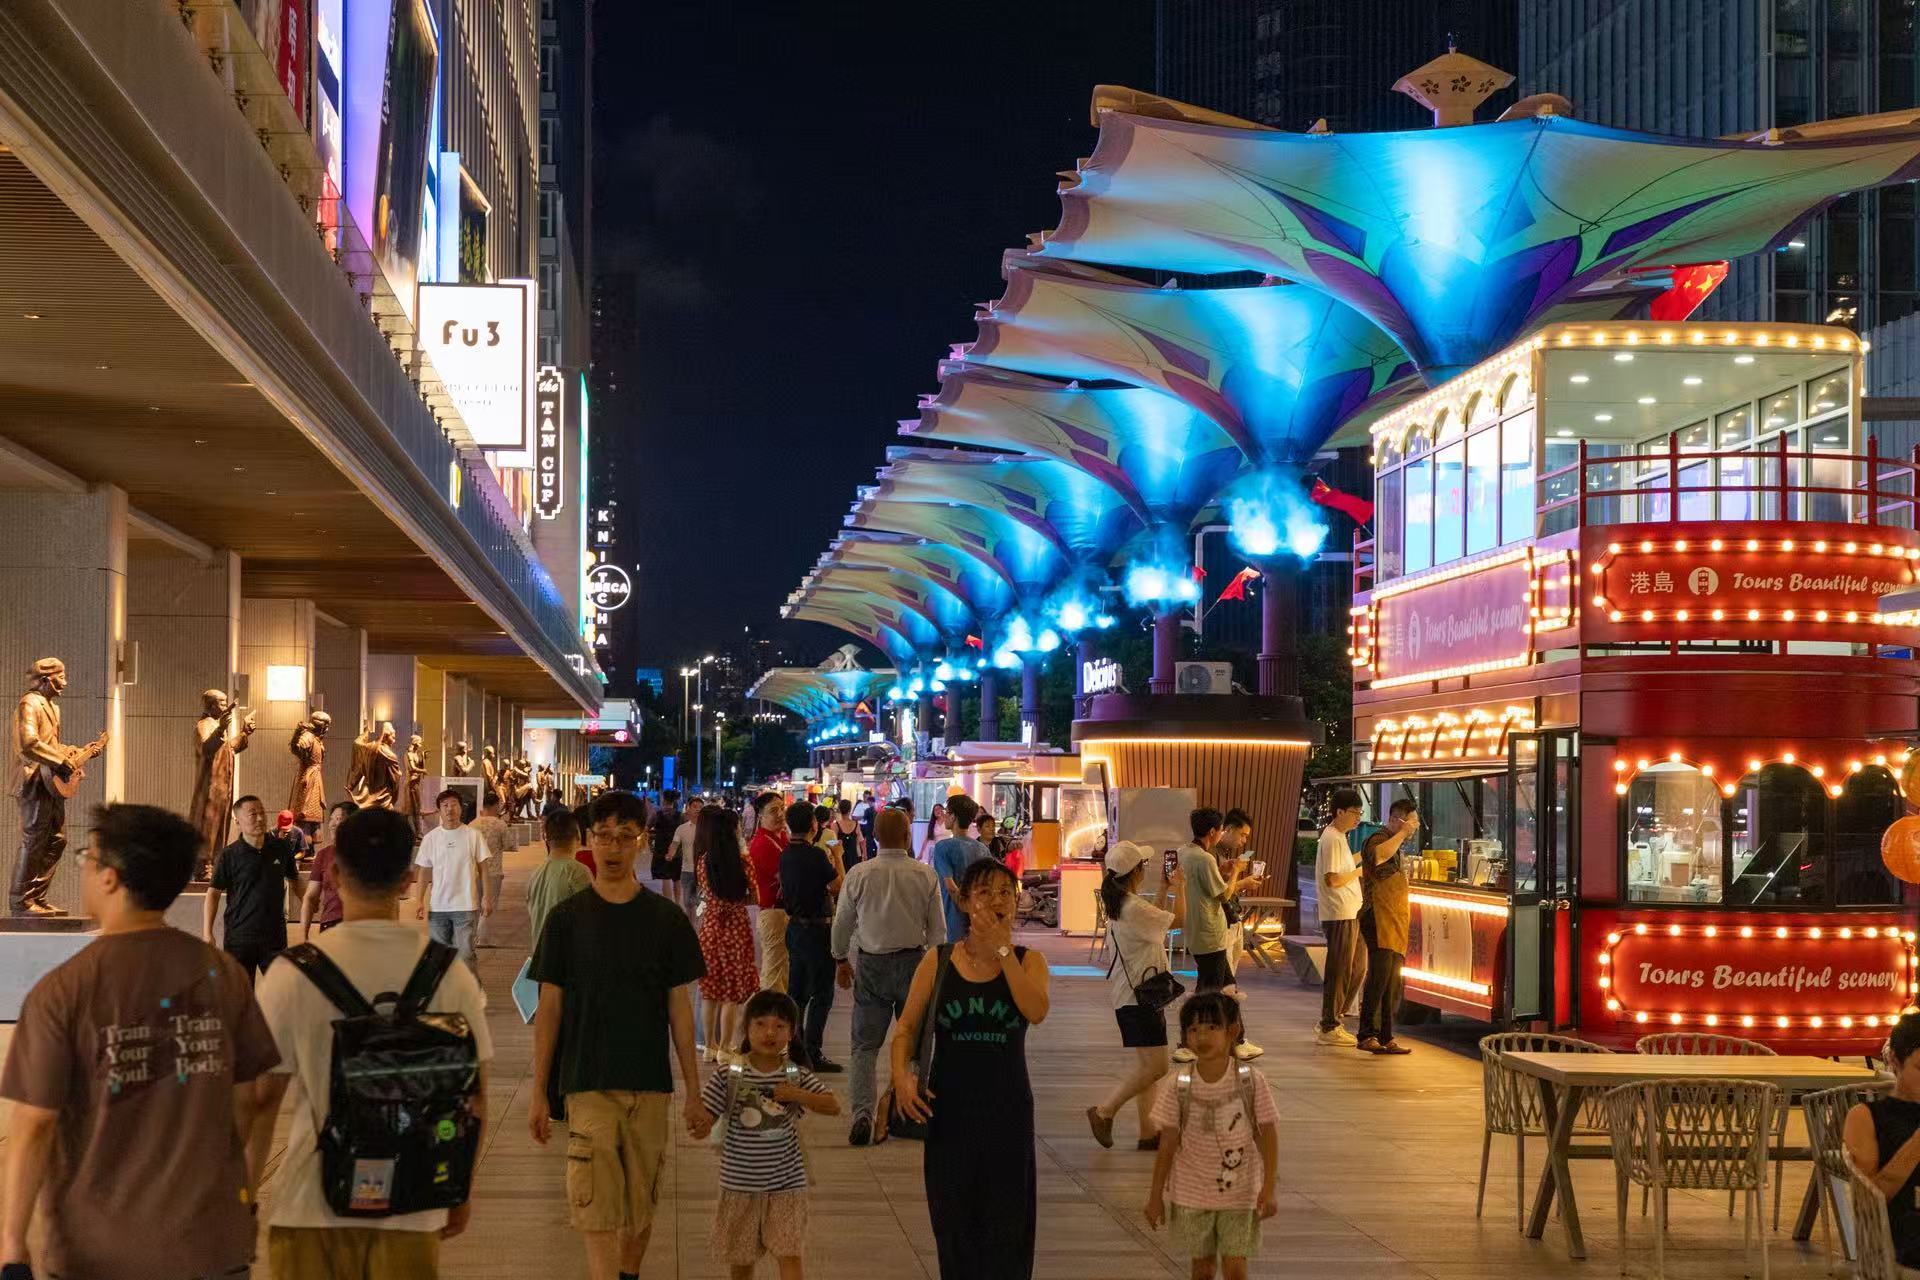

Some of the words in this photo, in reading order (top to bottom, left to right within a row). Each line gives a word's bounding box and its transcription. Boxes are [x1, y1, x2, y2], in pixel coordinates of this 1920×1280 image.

[539, 379, 559, 392] the
[541, 401, 556, 447] TAN
[541, 457, 556, 503] CUP
[1630, 571, 1674, 594] 港島
[1733, 573, 1783, 591] Tours
[1789, 573, 1868, 595] Beautiful
[1640, 962, 1704, 988] Tours
[1712, 965, 1831, 992] Beautiful
[1838, 971, 1899, 992] scenery
[101, 1023, 151, 1044] Train
[168, 1012, 222, 1034] Train
[105, 1043, 152, 1065] Your
[175, 1034, 221, 1055] Your
